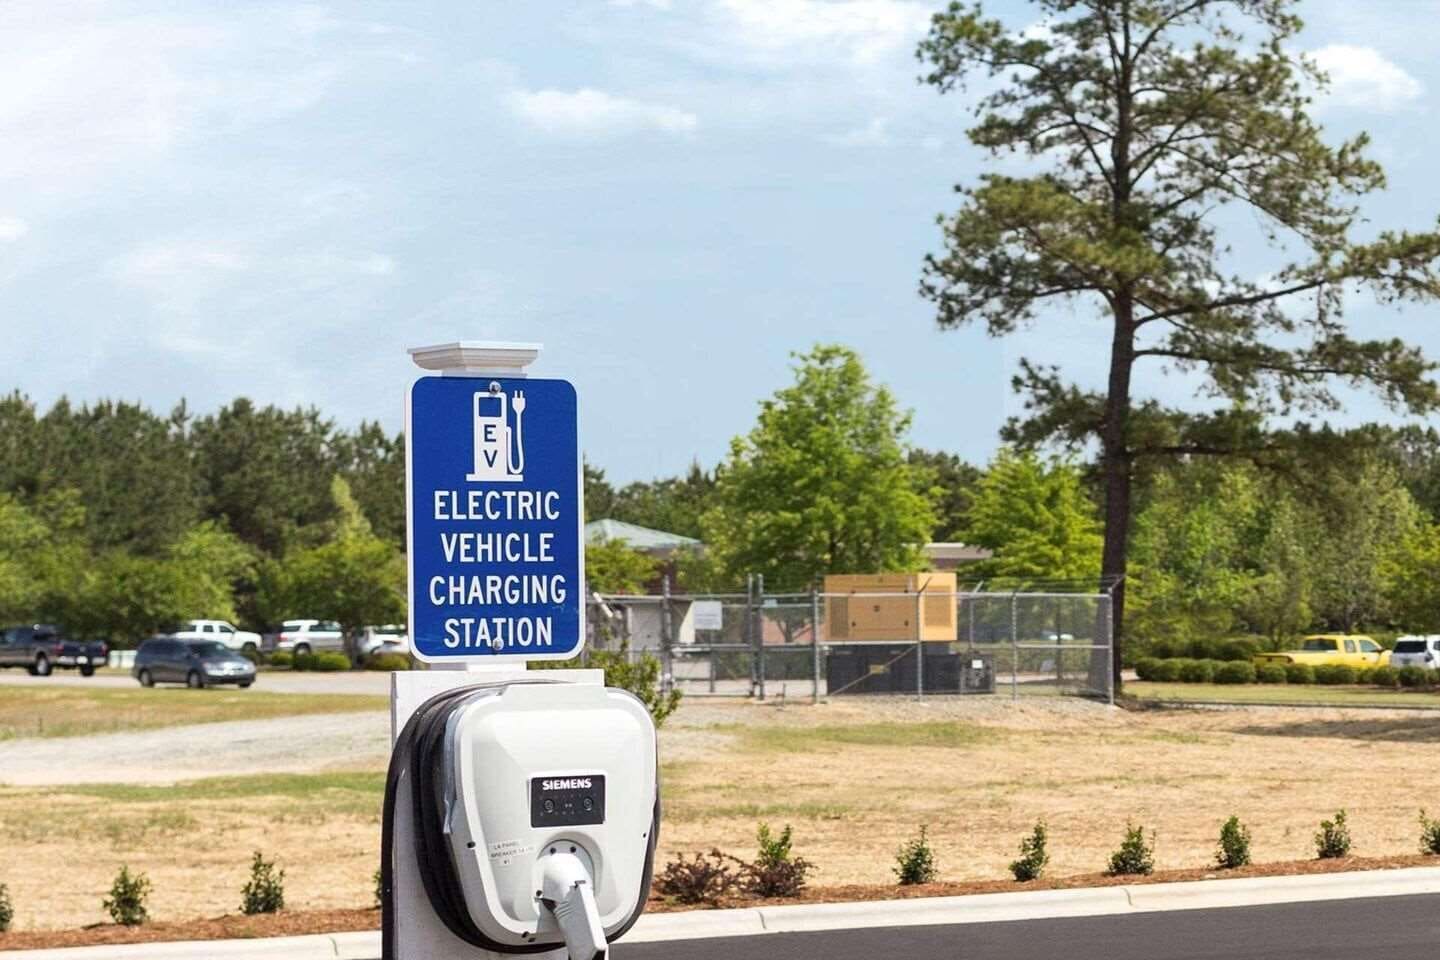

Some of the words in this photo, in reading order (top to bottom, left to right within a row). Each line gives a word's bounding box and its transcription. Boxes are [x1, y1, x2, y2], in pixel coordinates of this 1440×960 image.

[484, 424, 498, 468] EV
[434, 490, 560, 520] ELECTRIC
[440, 533, 555, 563] VEHICLE
[429, 575, 567, 605] CHARGING
[443, 616, 553, 649] STATION
[542, 778, 592, 791] SIEMENS
